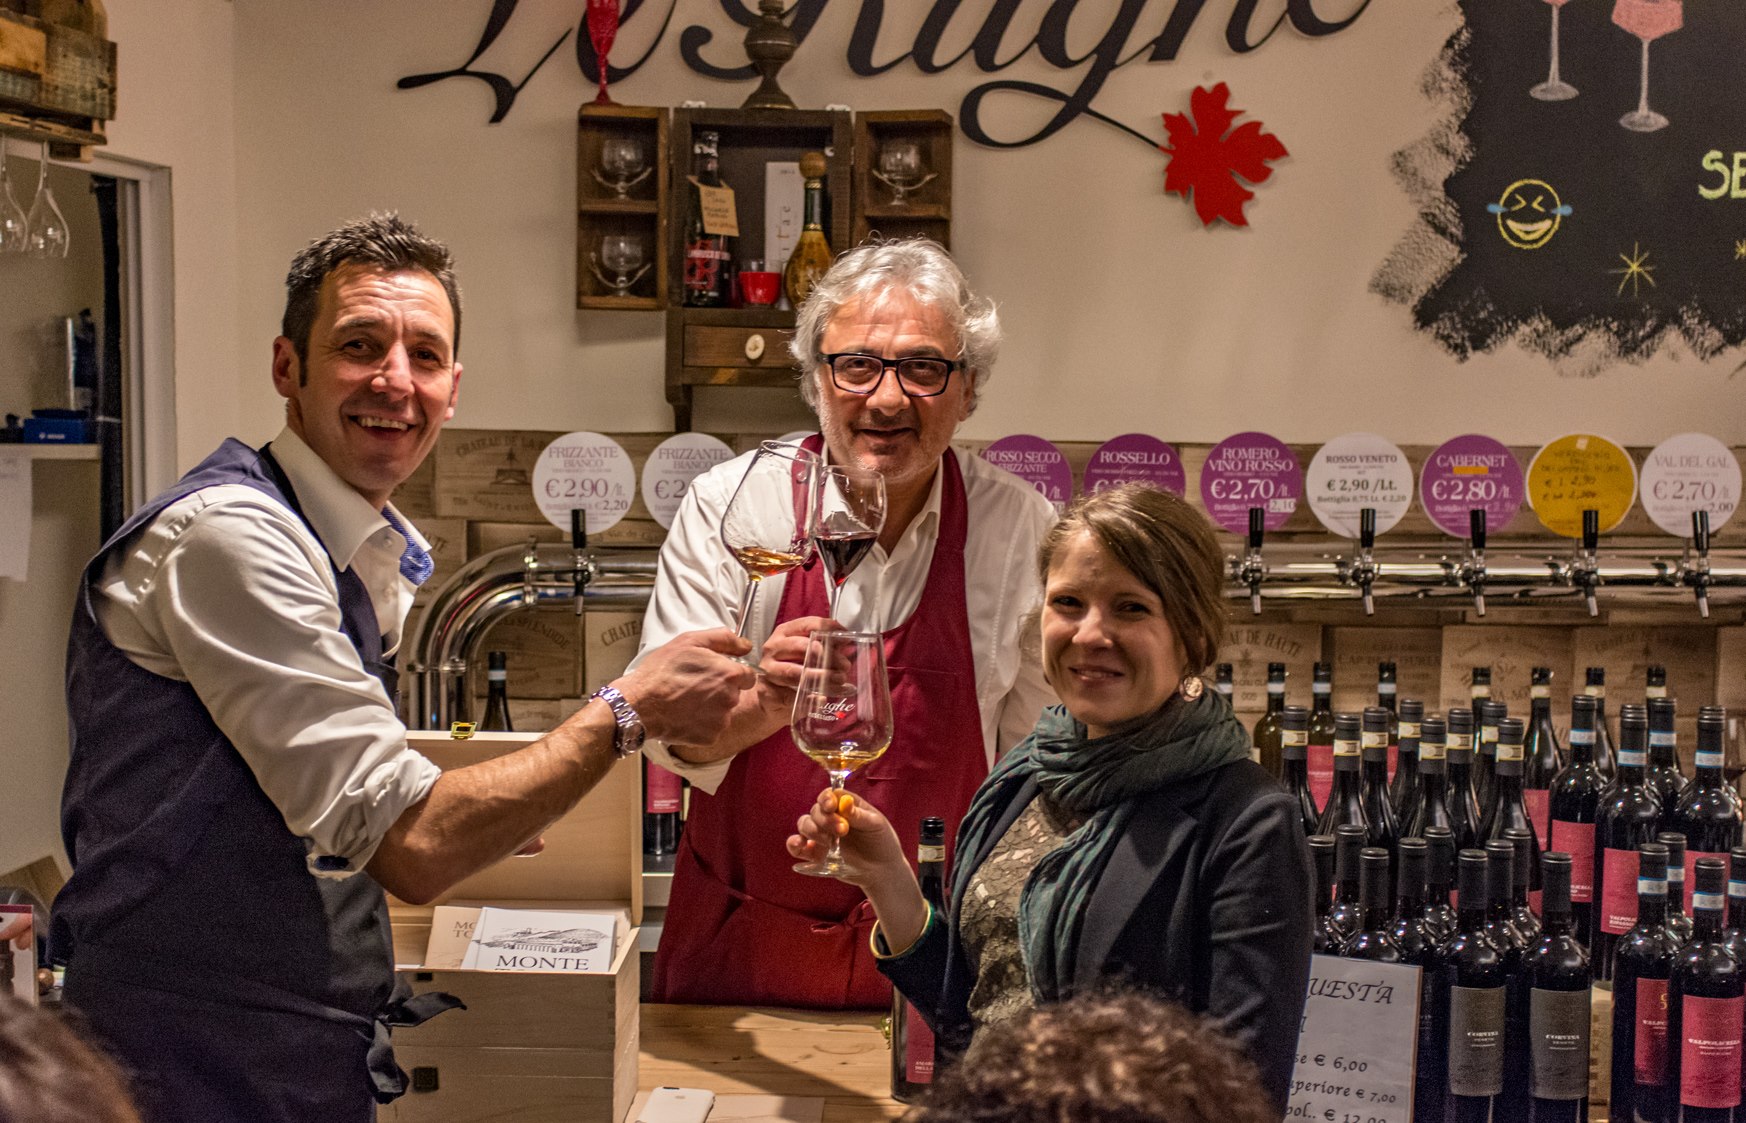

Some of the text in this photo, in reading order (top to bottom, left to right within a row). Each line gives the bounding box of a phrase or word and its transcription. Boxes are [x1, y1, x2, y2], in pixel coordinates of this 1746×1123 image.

[548, 446, 619, 459] FRIZZANTE
[658, 447, 728, 460] FRIZZANTE
[986, 450, 1061, 464] ROSSO SECCO
[1100, 451, 1171, 465] ROSSELLO
[1222, 447, 1280, 460] ROMERO
[563, 460, 604, 468] BIANCO
[1208, 459, 1294, 472] VINO ROSSO
[1326, 455, 1398, 464] ROSSO VENETO
[1436, 454, 1508, 467] CABERNET
[1654, 456, 1677, 468] VAL
[496, 954, 590, 972] MONTE
[1306, 977, 1395, 1004] UESTA
[1314, 1054, 1326, 1067] €
[1333, 1057, 1369, 1073] 6,00
[1355, 1088, 1365, 1099] €
[1369, 1092, 1397, 1104] 7,00
[1323, 1108, 1336, 1122] €
